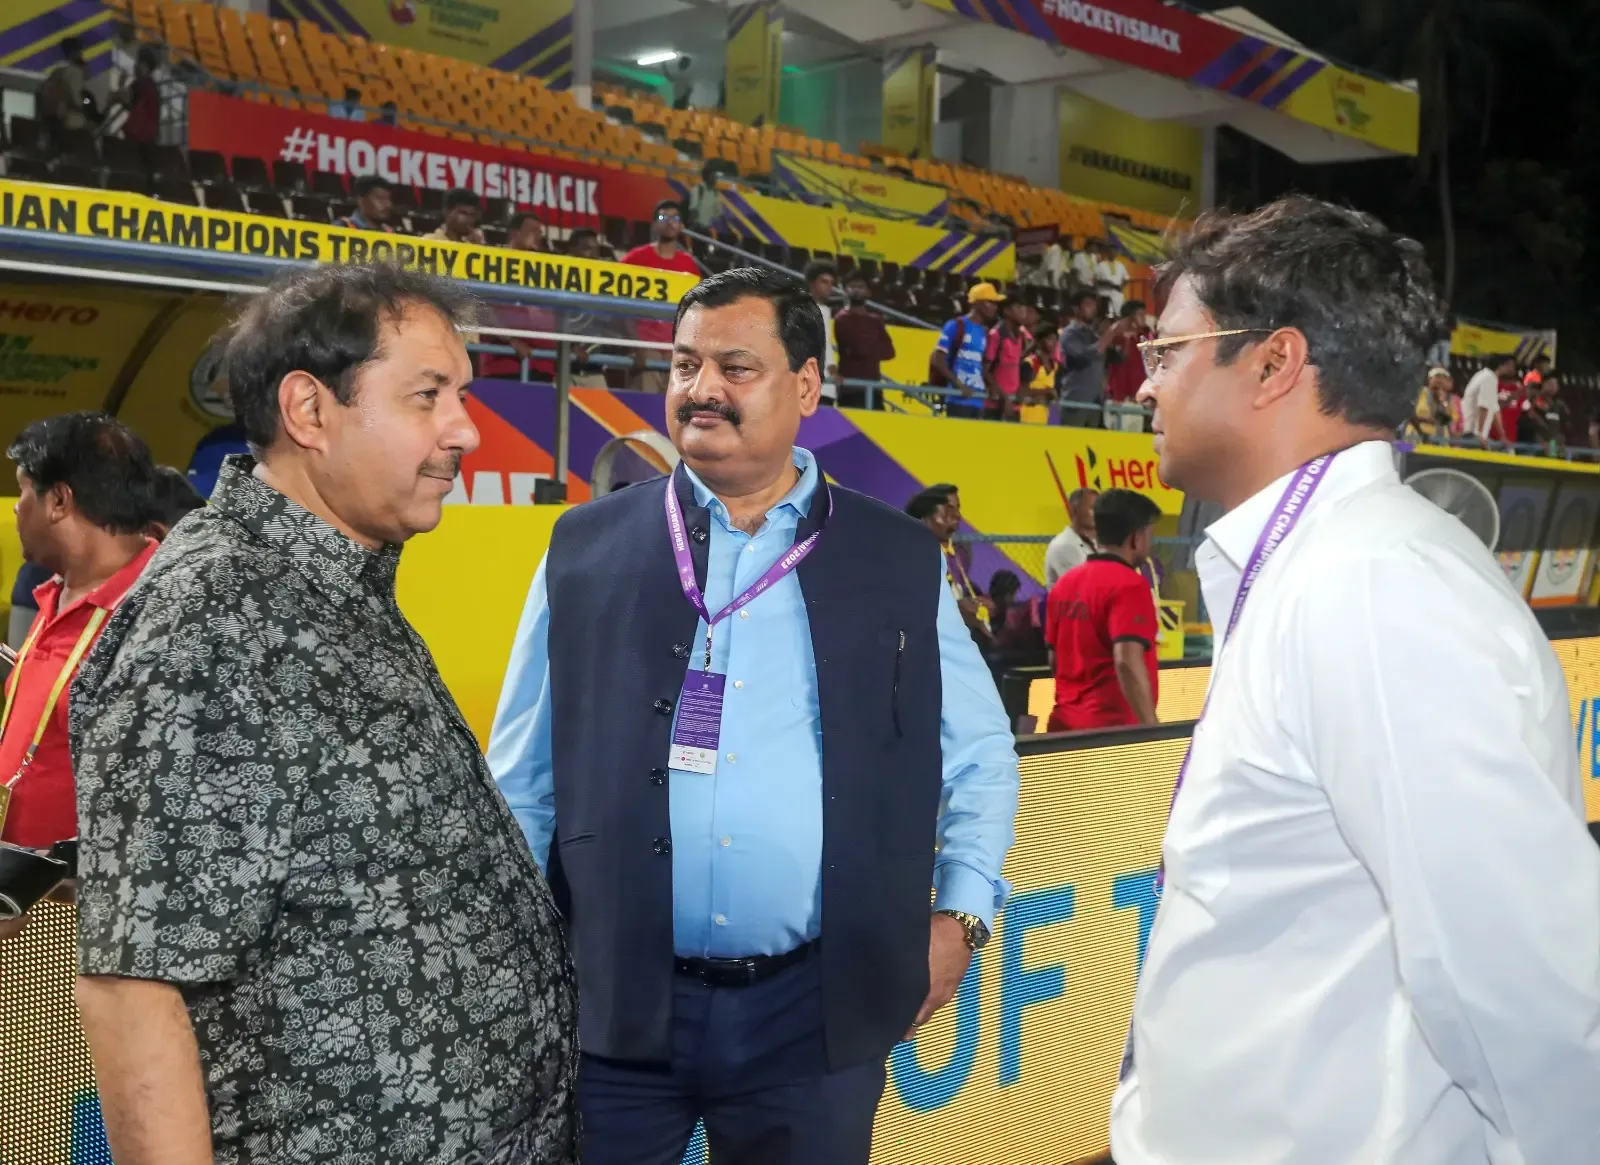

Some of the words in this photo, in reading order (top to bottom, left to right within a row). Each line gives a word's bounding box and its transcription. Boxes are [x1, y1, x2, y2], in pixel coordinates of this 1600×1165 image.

[1042, 1, 1181, 54] #HOCKEYISBACK
[279, 127, 599, 215] #HOCKEYISBACK
[87, 202, 319, 259] CHAMPIONS
[328, 234, 457, 279] TROPHY
[464, 251, 592, 294] CHENNAI
[600, 270, 668, 302] 2023
[1283, 473, 1315, 515] ASIAN
[674, 532, 685, 552] HERO
[781, 549, 801, 570] 2023
